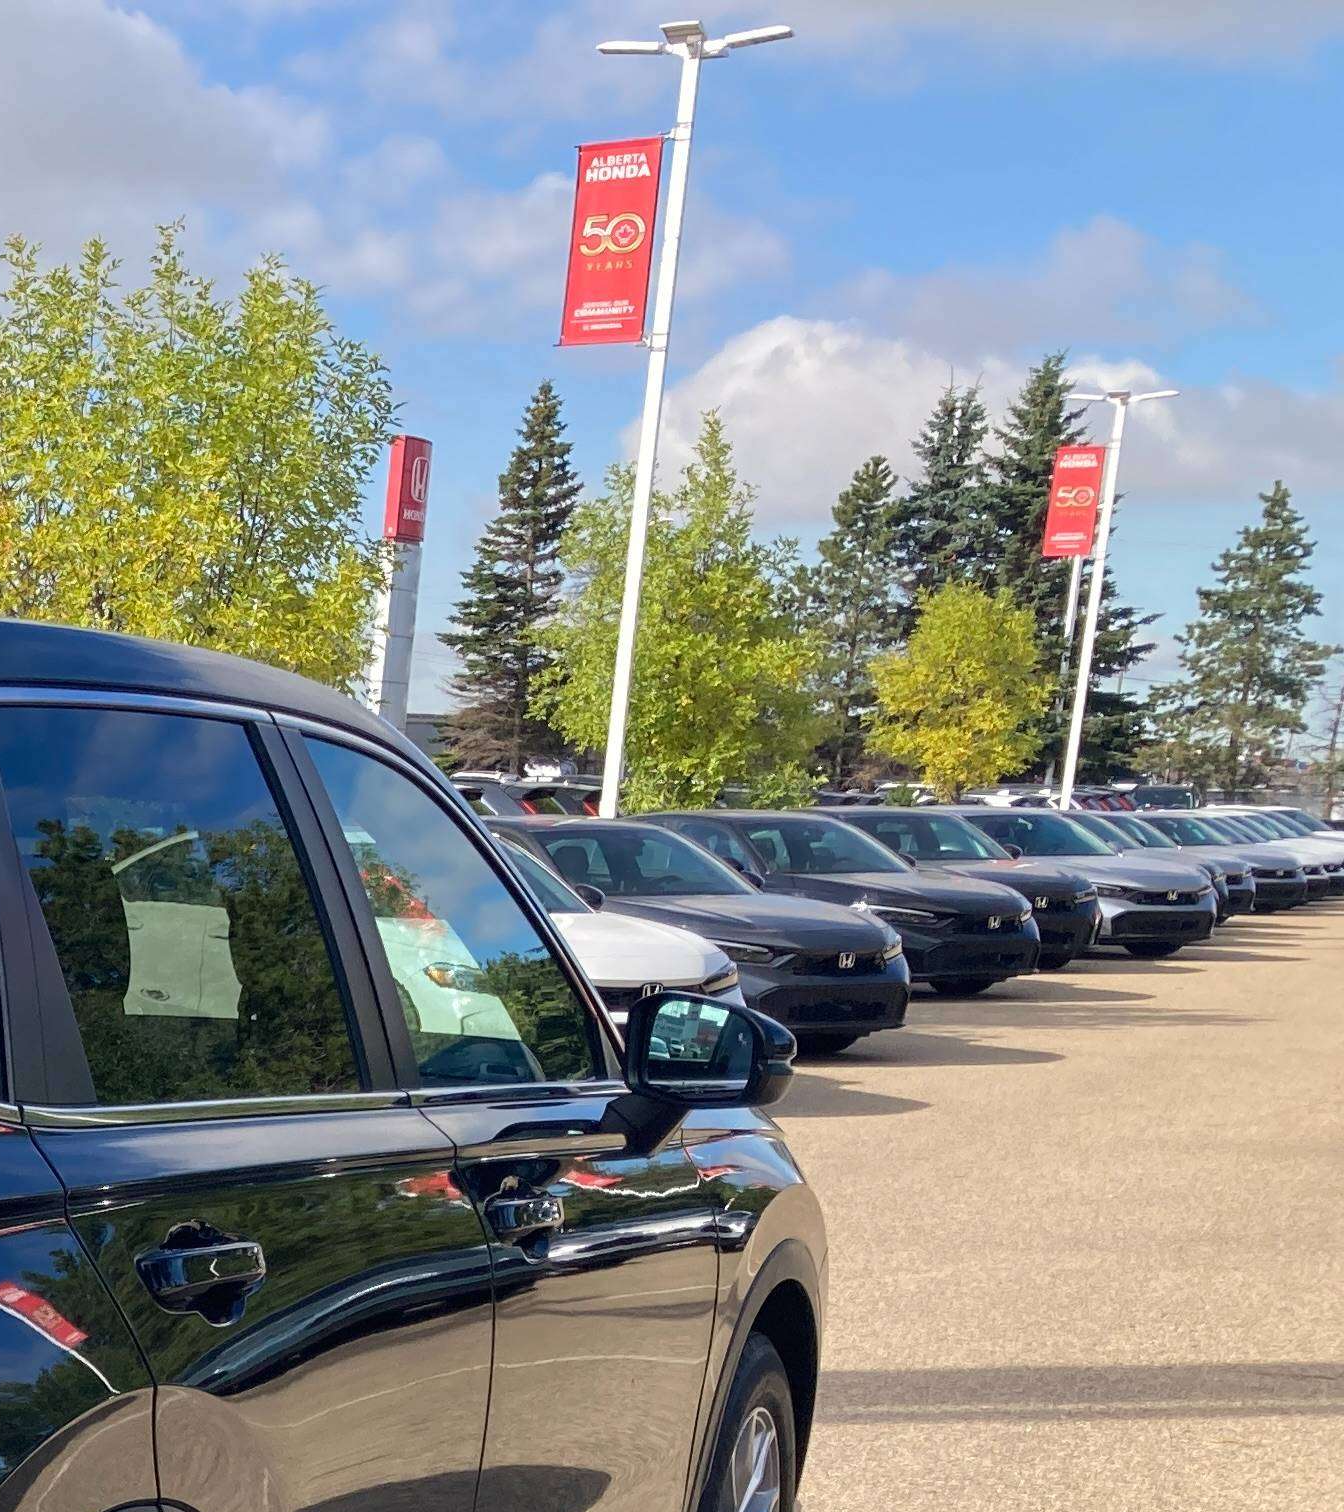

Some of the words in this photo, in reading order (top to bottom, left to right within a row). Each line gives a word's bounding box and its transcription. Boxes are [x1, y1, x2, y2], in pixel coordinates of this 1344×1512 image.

[590, 153, 647, 168] ALBERTA
[585, 164, 651, 183] HONDA
[579, 212, 647, 257] 50
[585, 259, 634, 272] YEARS
[1055, 486, 1095, 507] 50
